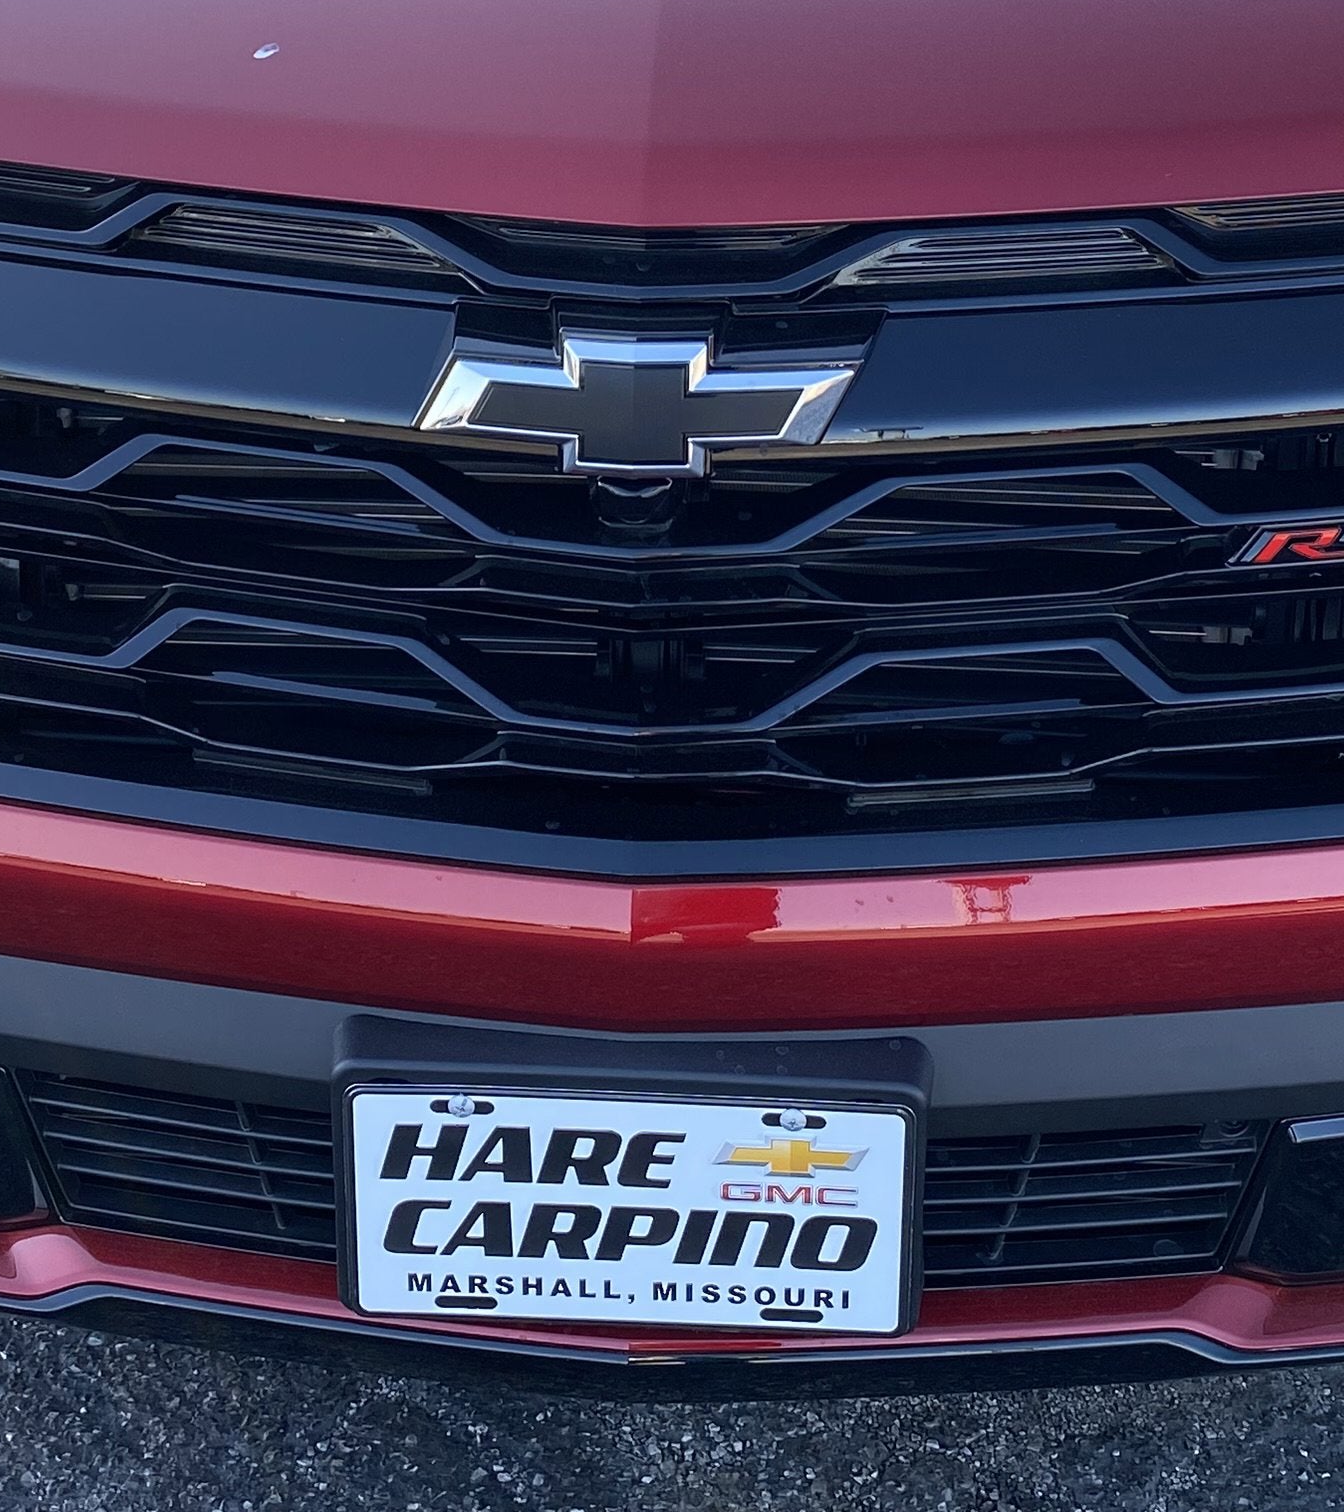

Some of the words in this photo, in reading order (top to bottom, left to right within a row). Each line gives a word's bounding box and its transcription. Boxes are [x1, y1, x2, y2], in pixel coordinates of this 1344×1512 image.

[379, 1122, 687, 1189] HARE
[719, 1180, 860, 1209] GMC
[382, 1198, 878, 1272] CARPINO
[407, 1272, 635, 1305] MARSHALL,
[652, 1281, 851, 1310] MISSOURI
